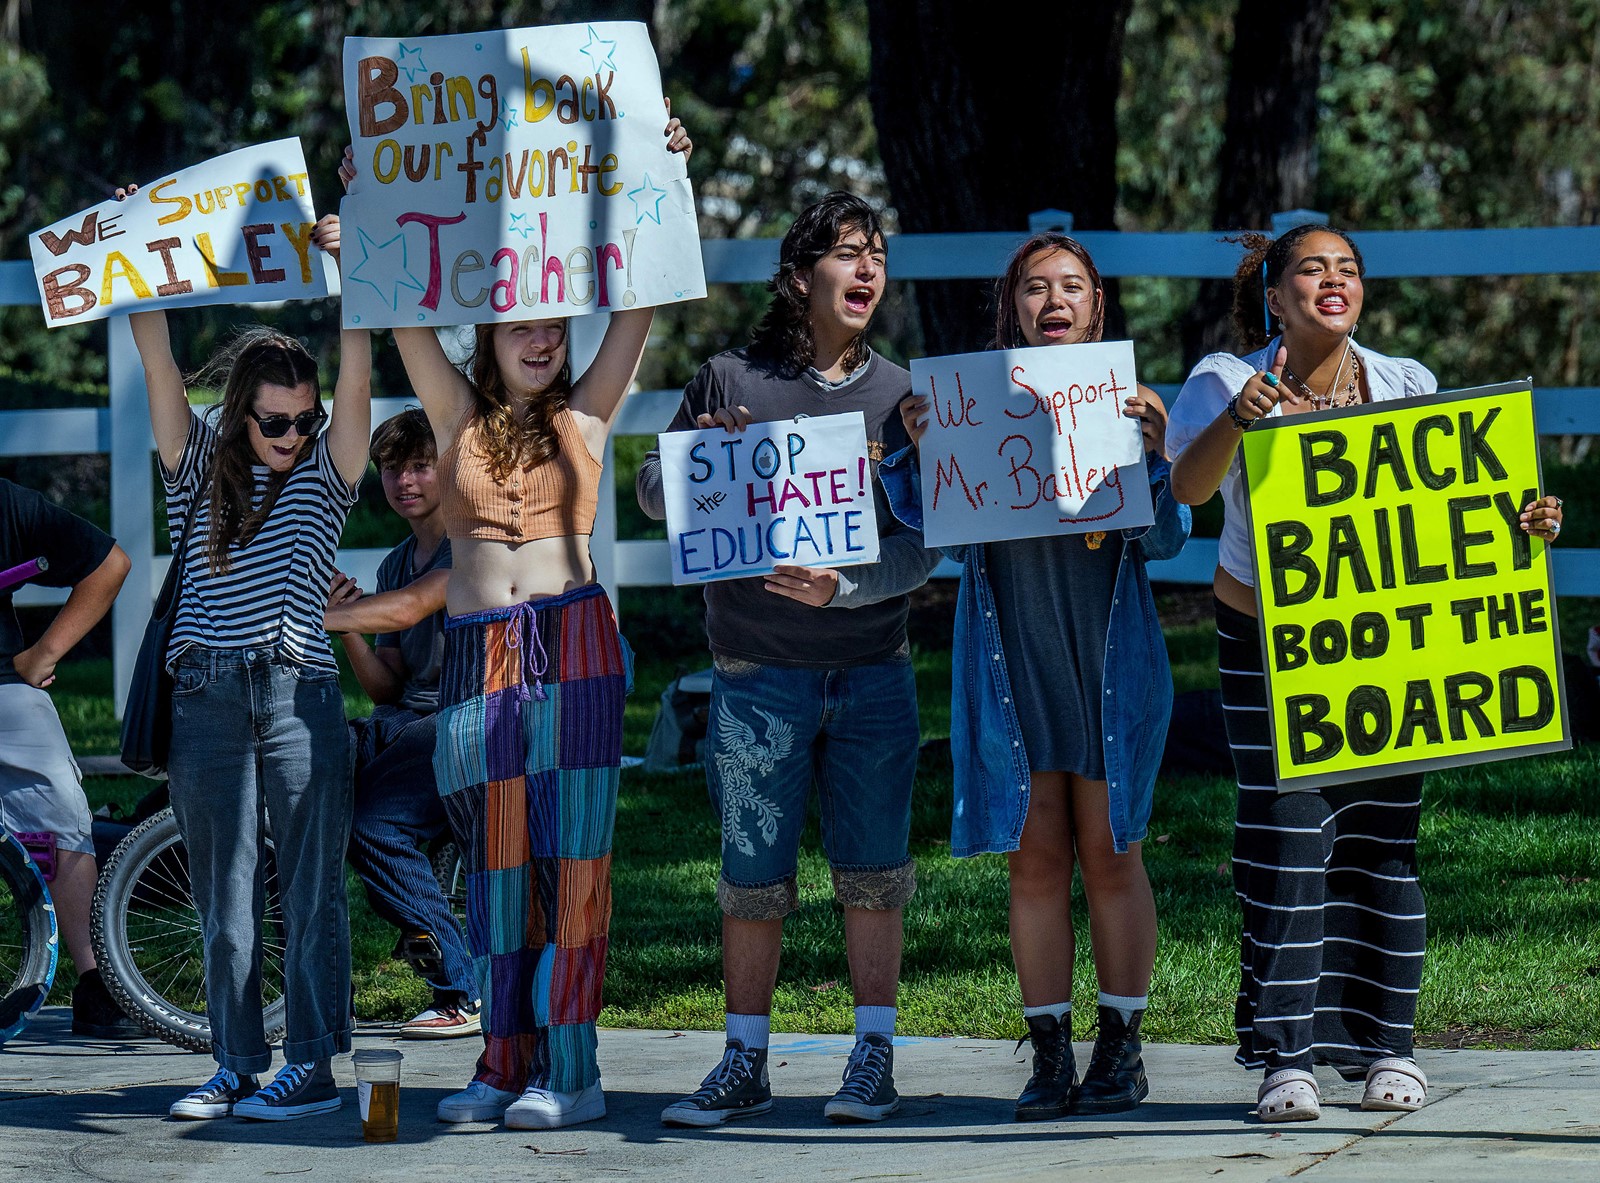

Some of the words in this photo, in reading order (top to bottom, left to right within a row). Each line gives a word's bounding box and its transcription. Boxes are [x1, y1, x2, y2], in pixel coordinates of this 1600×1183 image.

[358, 55, 498, 138] Bring
[520, 46, 615, 124] back
[372, 139, 454, 185] our
[457, 125, 625, 203] favorite
[38, 211, 126, 256] WE
[149, 178, 308, 226] SUPPORT
[42, 222, 314, 320] BAILEY
[395, 211, 638, 313] Teacher!
[930, 372, 983, 429] We
[1004, 366, 1127, 435] Support
[688, 433, 805, 484] STOP
[693, 490, 727, 514] the
[747, 457, 866, 517] HATE!
[933, 454, 998, 510] Mr.
[998, 434, 1124, 523] Bailey
[1298, 407, 1508, 507] BACK
[679, 511, 865, 574] EDUCATE
[1266, 488, 1538, 607] BAILEY
[1272, 602, 1433, 672] BOOT
[1450, 588, 1548, 644] THE
[1284, 665, 1555, 766] BOARD
